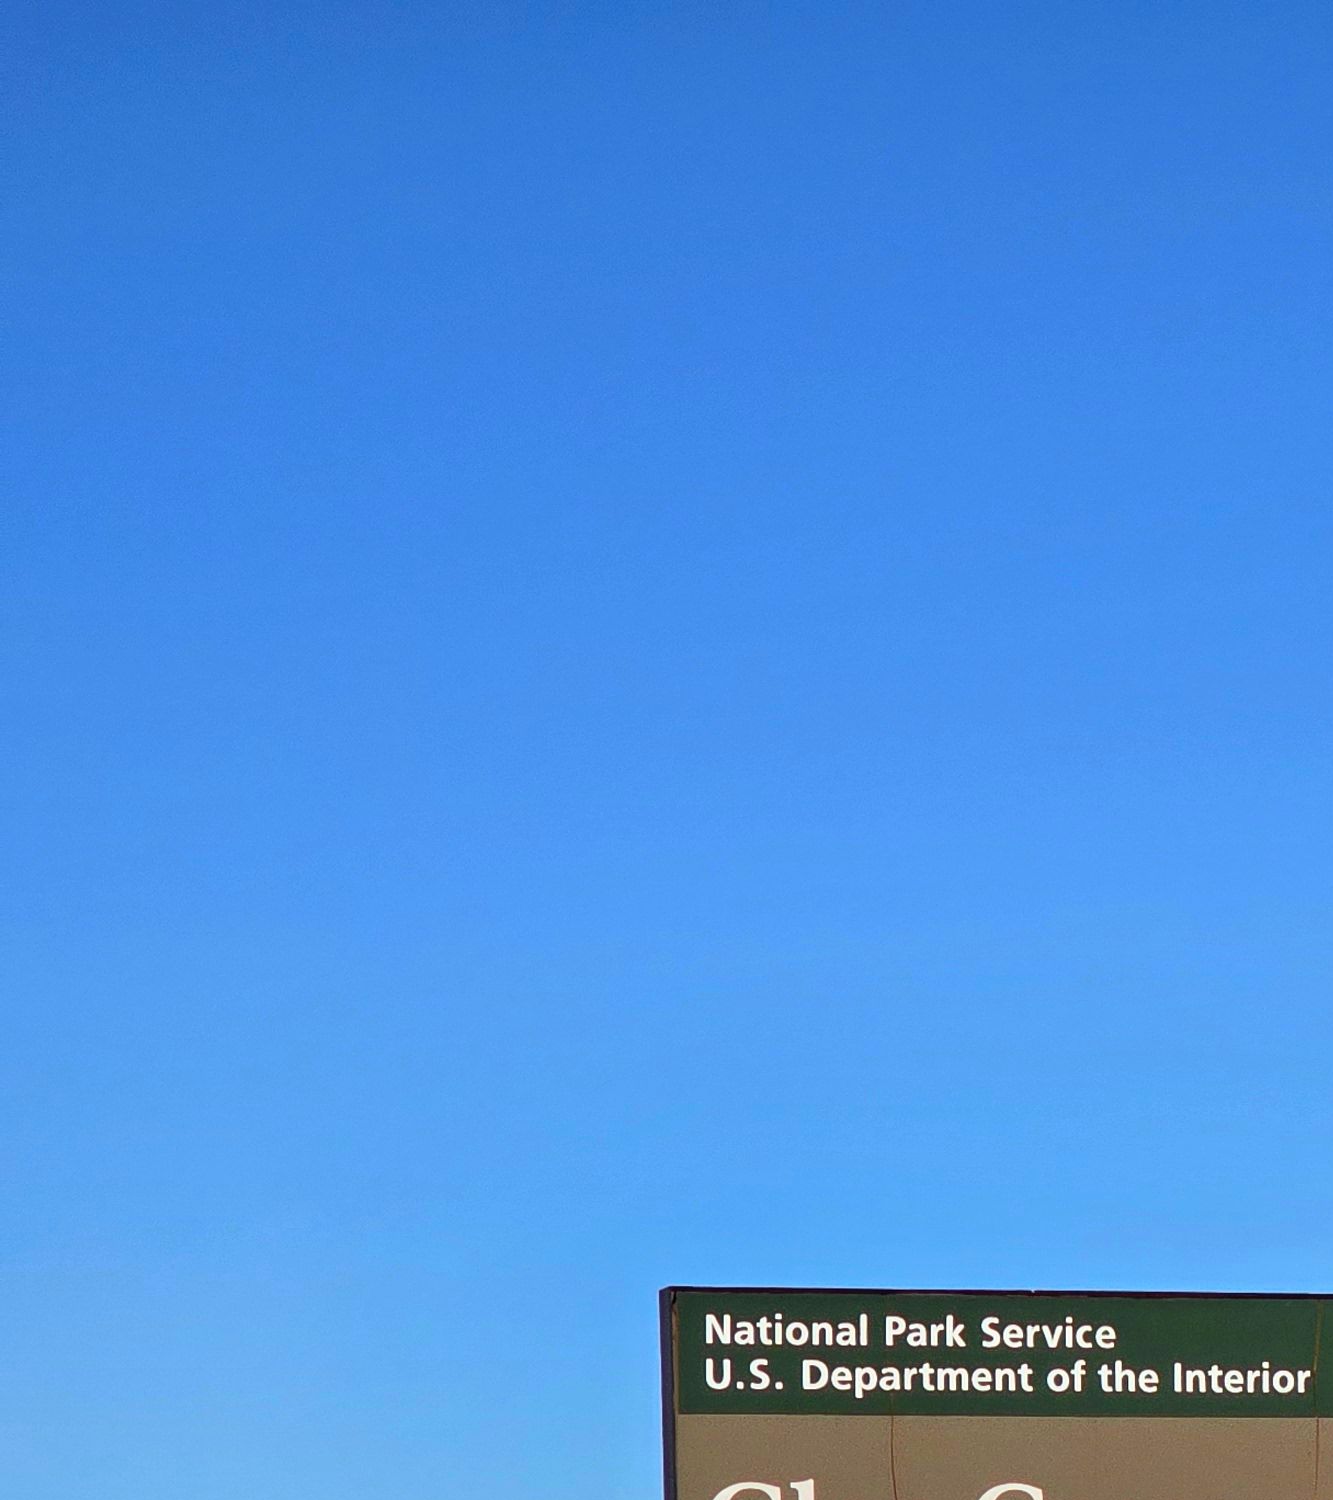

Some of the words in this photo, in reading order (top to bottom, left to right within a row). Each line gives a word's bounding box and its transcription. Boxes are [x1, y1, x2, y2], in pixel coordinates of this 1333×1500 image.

[705, 1313, 868, 1346] National
[885, 1314, 966, 1347] Park
[980, 1316, 1116, 1349] Service
[705, 1358, 784, 1390] U.S.
[802, 1359, 1034, 1399] Department
[1046, 1359, 1086, 1392] of
[1097, 1359, 1159, 1393] the
[1173, 1361, 1311, 1394] Interior
